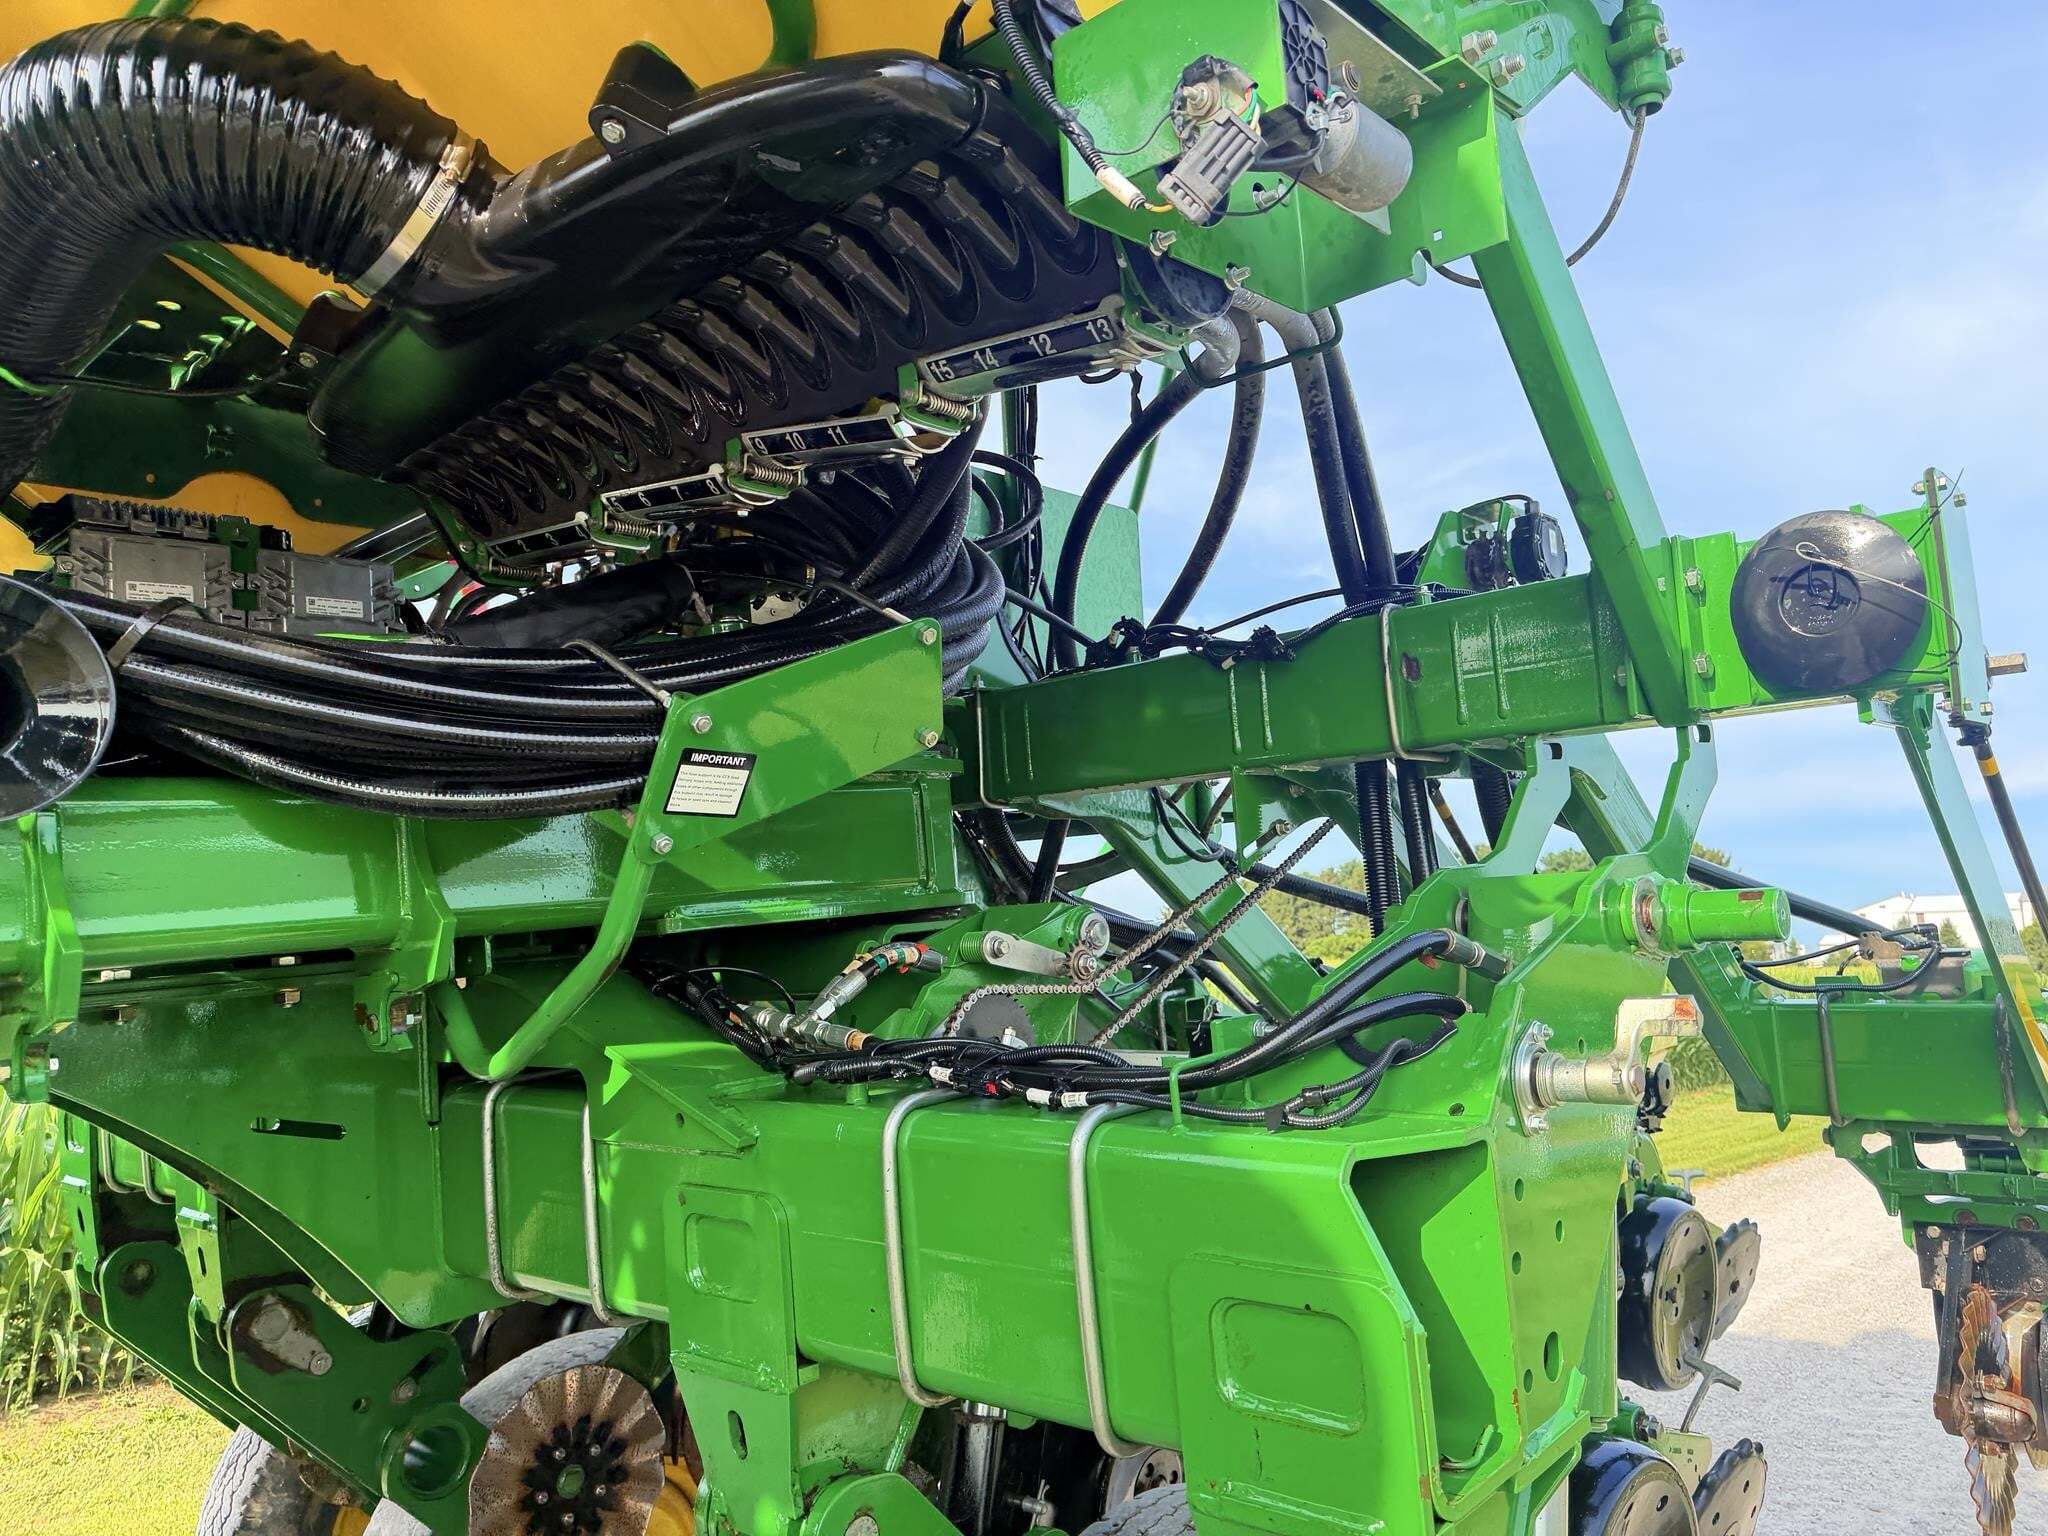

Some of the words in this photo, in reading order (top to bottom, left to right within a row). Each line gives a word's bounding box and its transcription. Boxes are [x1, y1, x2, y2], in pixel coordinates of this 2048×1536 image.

[929, 359, 956, 381] 15
[973, 347, 1000, 371] 14
[1028, 333, 1058, 357] 12
[1086, 318, 1114, 343] 13
[755, 438, 769, 455] 9
[785, 431, 805, 450] 10
[827, 426, 849, 445] 11
[637, 491, 652, 506] 6
[670, 485, 684, 500] 7
[705, 479, 720, 495] 8
[690, 752, 747, 766] IMPORTANT
